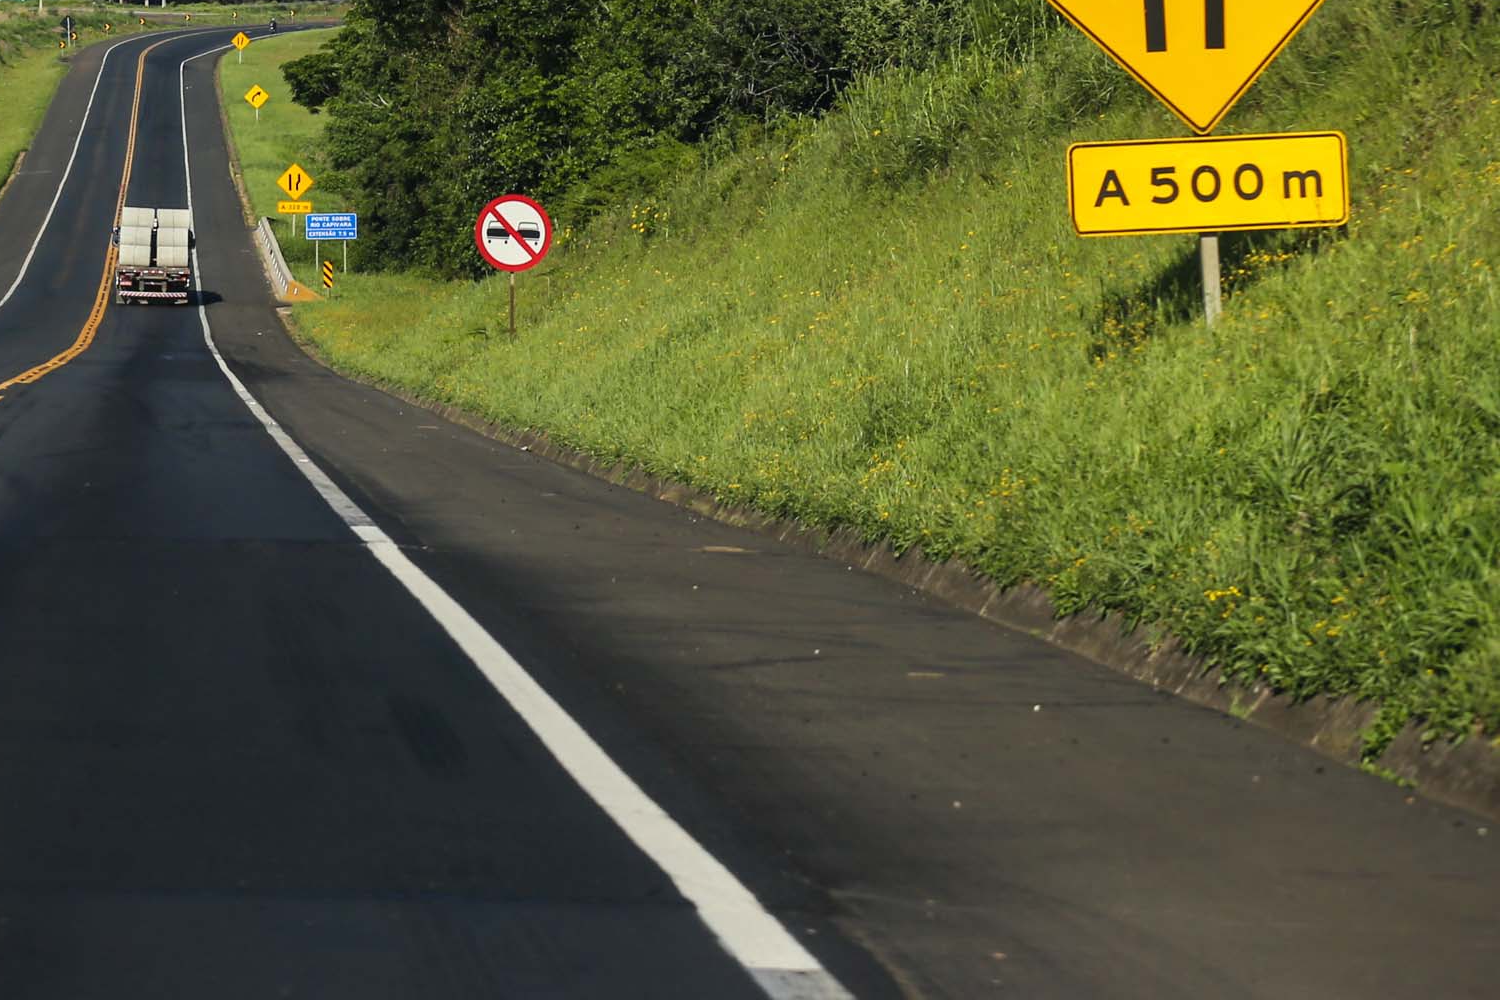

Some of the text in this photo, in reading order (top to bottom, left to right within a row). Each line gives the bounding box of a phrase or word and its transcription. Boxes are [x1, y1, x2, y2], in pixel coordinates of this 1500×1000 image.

[1094, 163, 1323, 208] A 500 m
